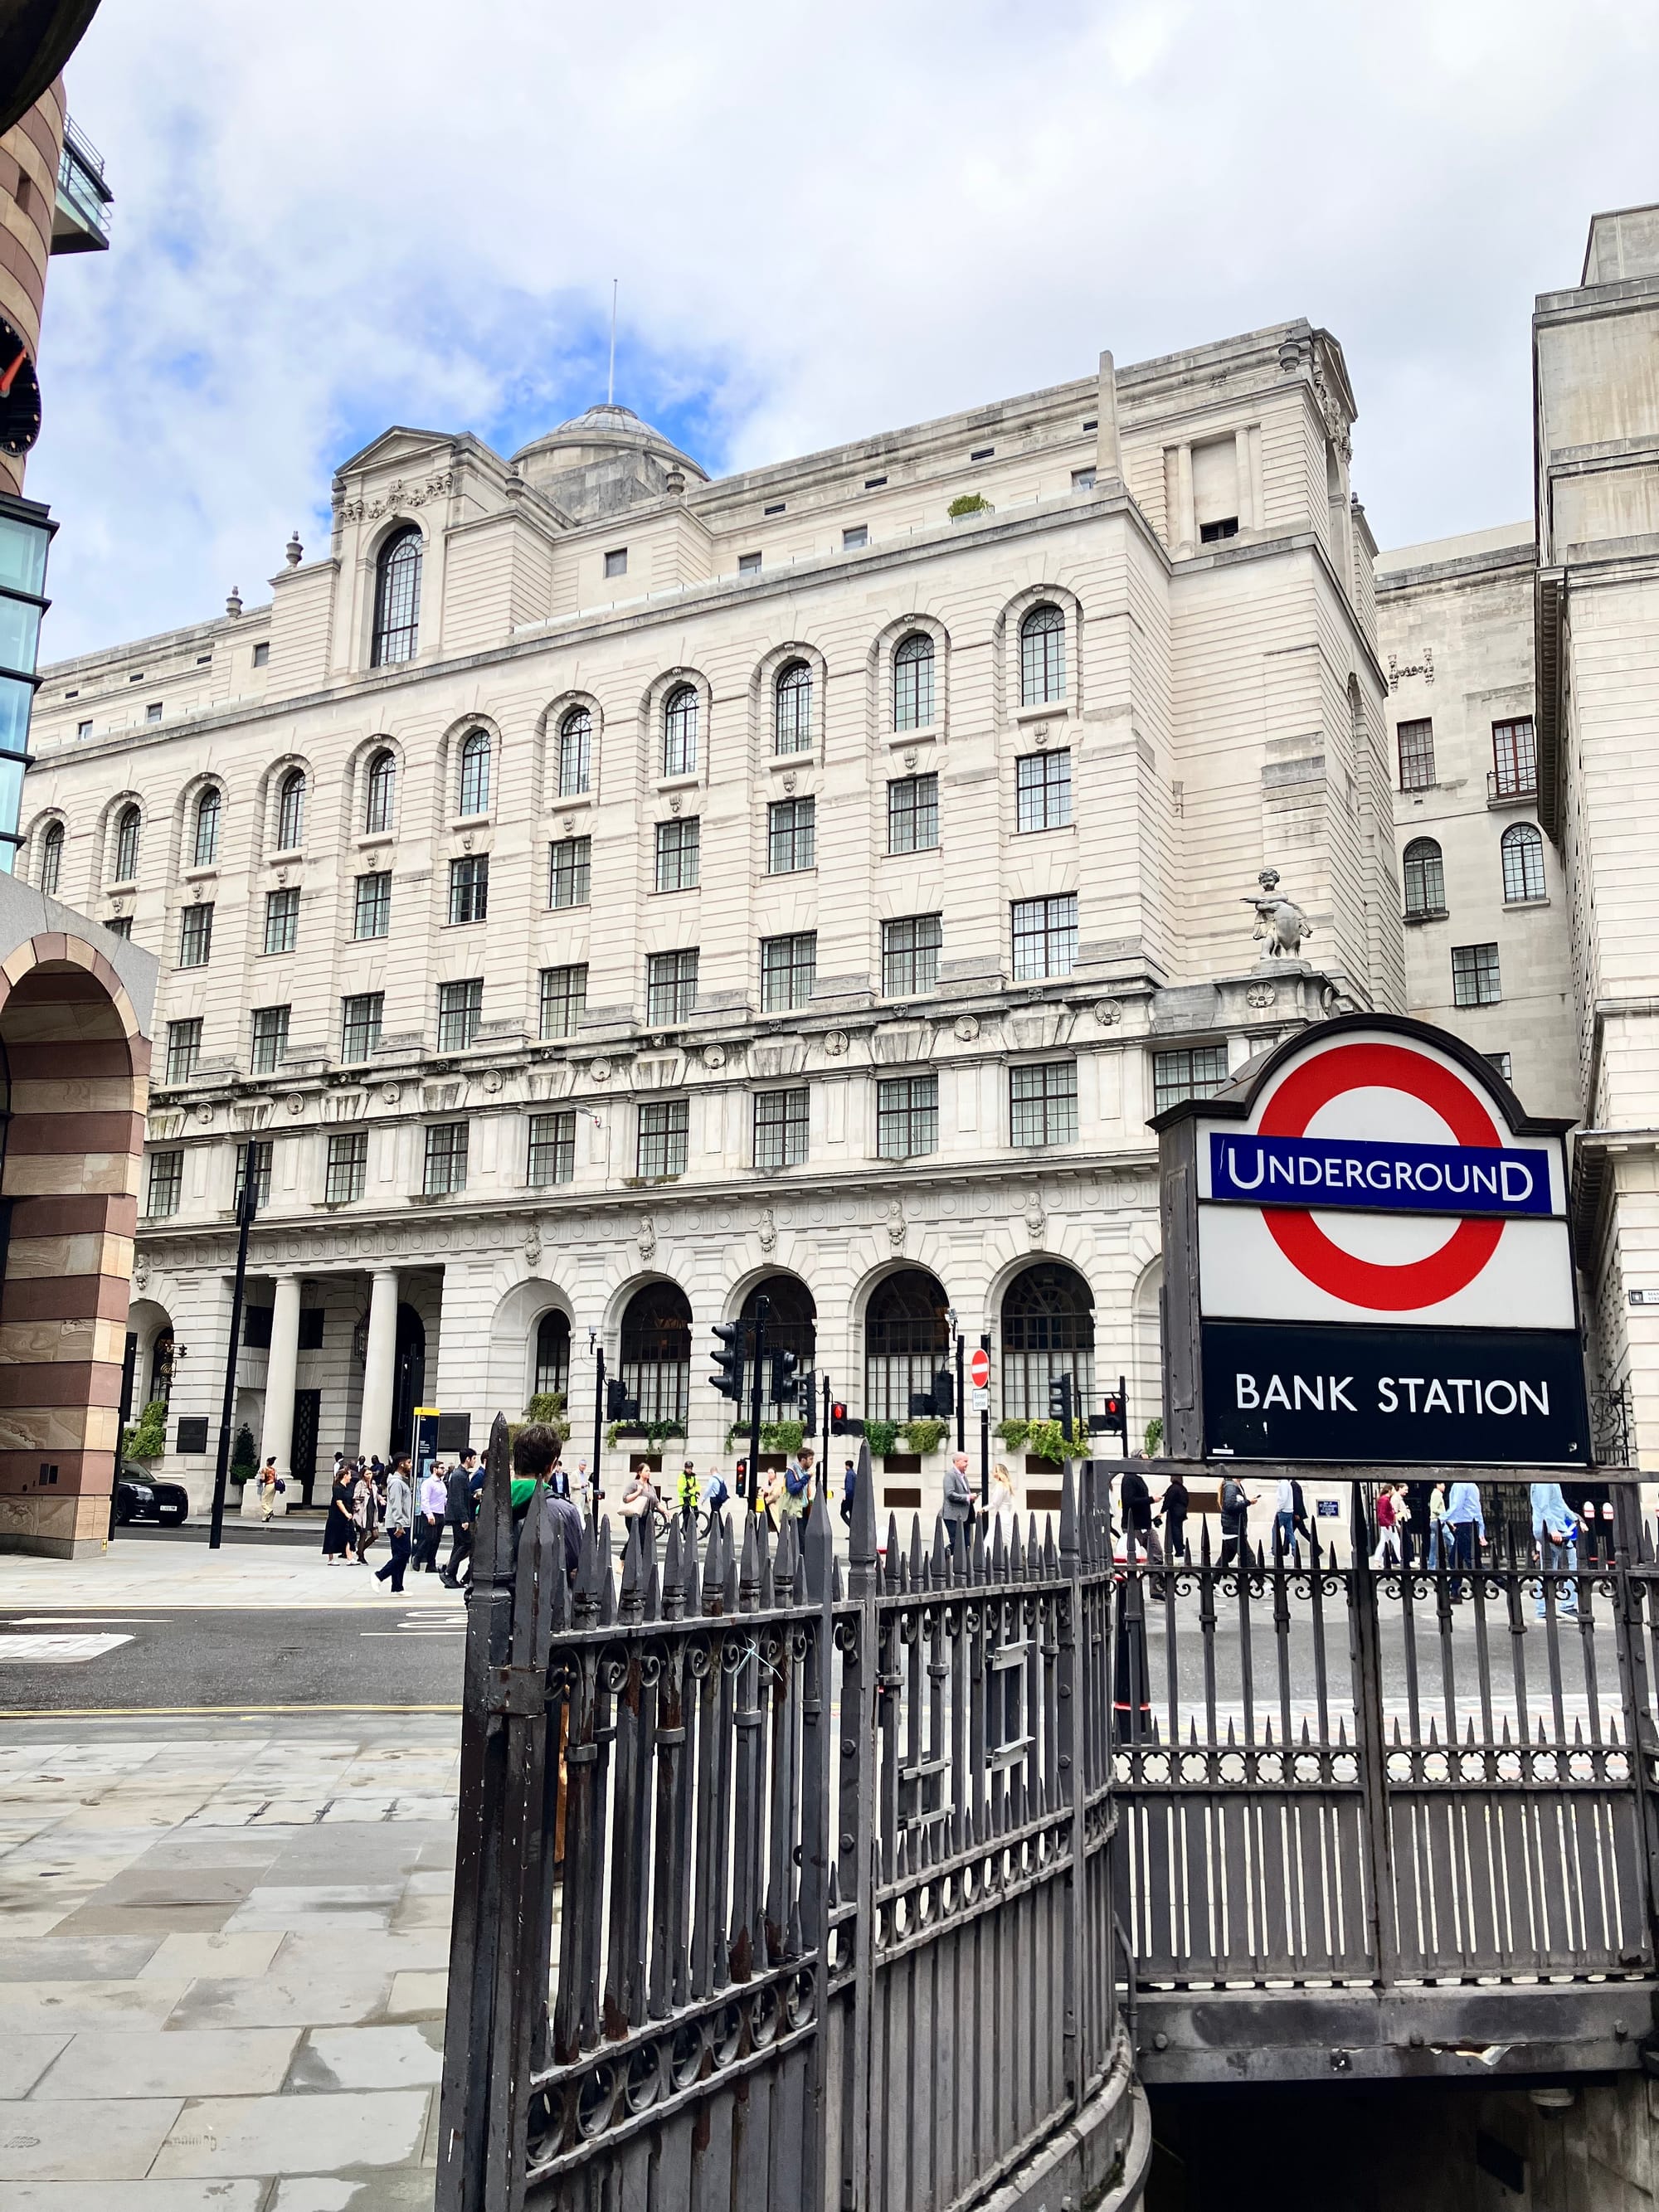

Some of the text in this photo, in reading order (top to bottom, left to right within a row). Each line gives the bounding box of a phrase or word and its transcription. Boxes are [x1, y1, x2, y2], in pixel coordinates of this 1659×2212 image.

[1228, 1147, 1534, 1202] UNDERGROUND
[1236, 1373, 1550, 1416] BANK STATION
